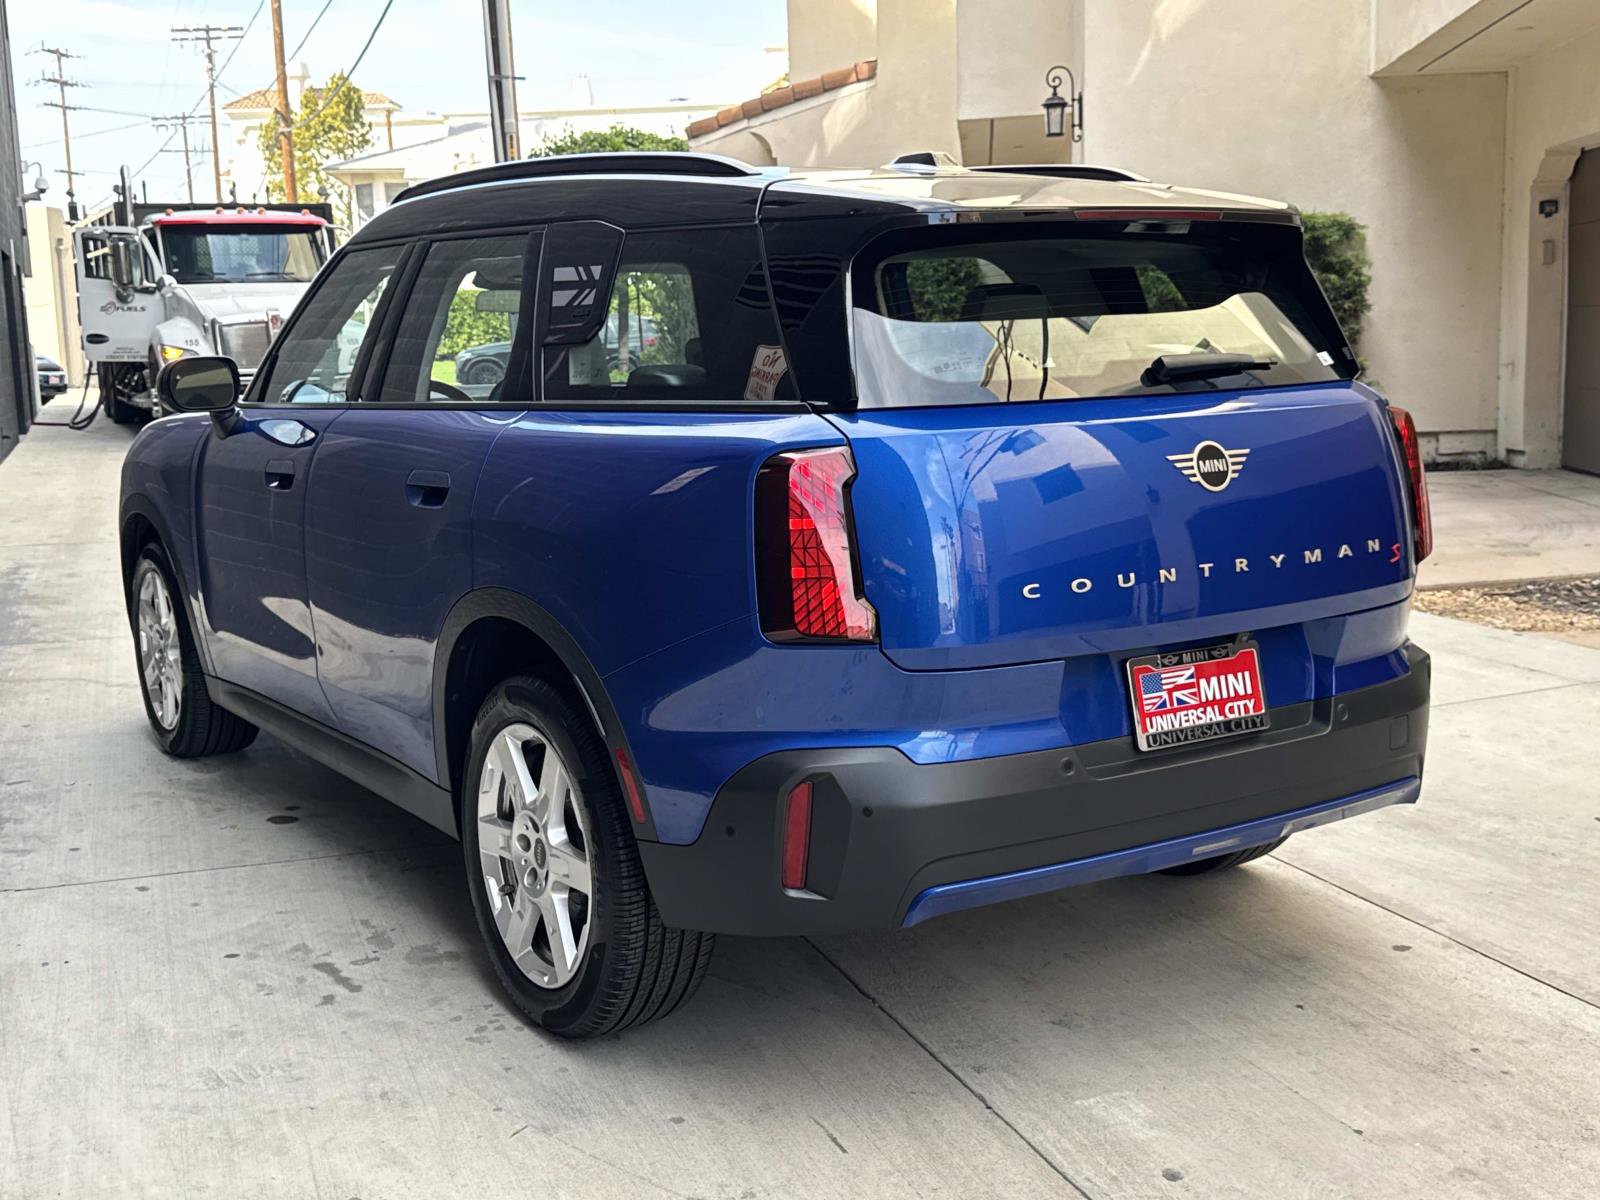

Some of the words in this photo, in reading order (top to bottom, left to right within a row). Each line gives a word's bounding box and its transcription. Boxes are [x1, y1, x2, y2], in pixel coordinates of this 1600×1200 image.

[1198, 457, 1228, 474] MINI
[1022, 538, 1380, 599] COUNTRYMAN
[1388, 543, 1401, 563] S
[1182, 650, 1209, 664] MINI
[1199, 671, 1252, 702] MINI
[1145, 705, 1225, 734] UNIVERSAL
[1224, 699, 1257, 720] CITY
[1148, 722, 1226, 747] UNIVERSAL
[1230, 716, 1263, 731] CITY
